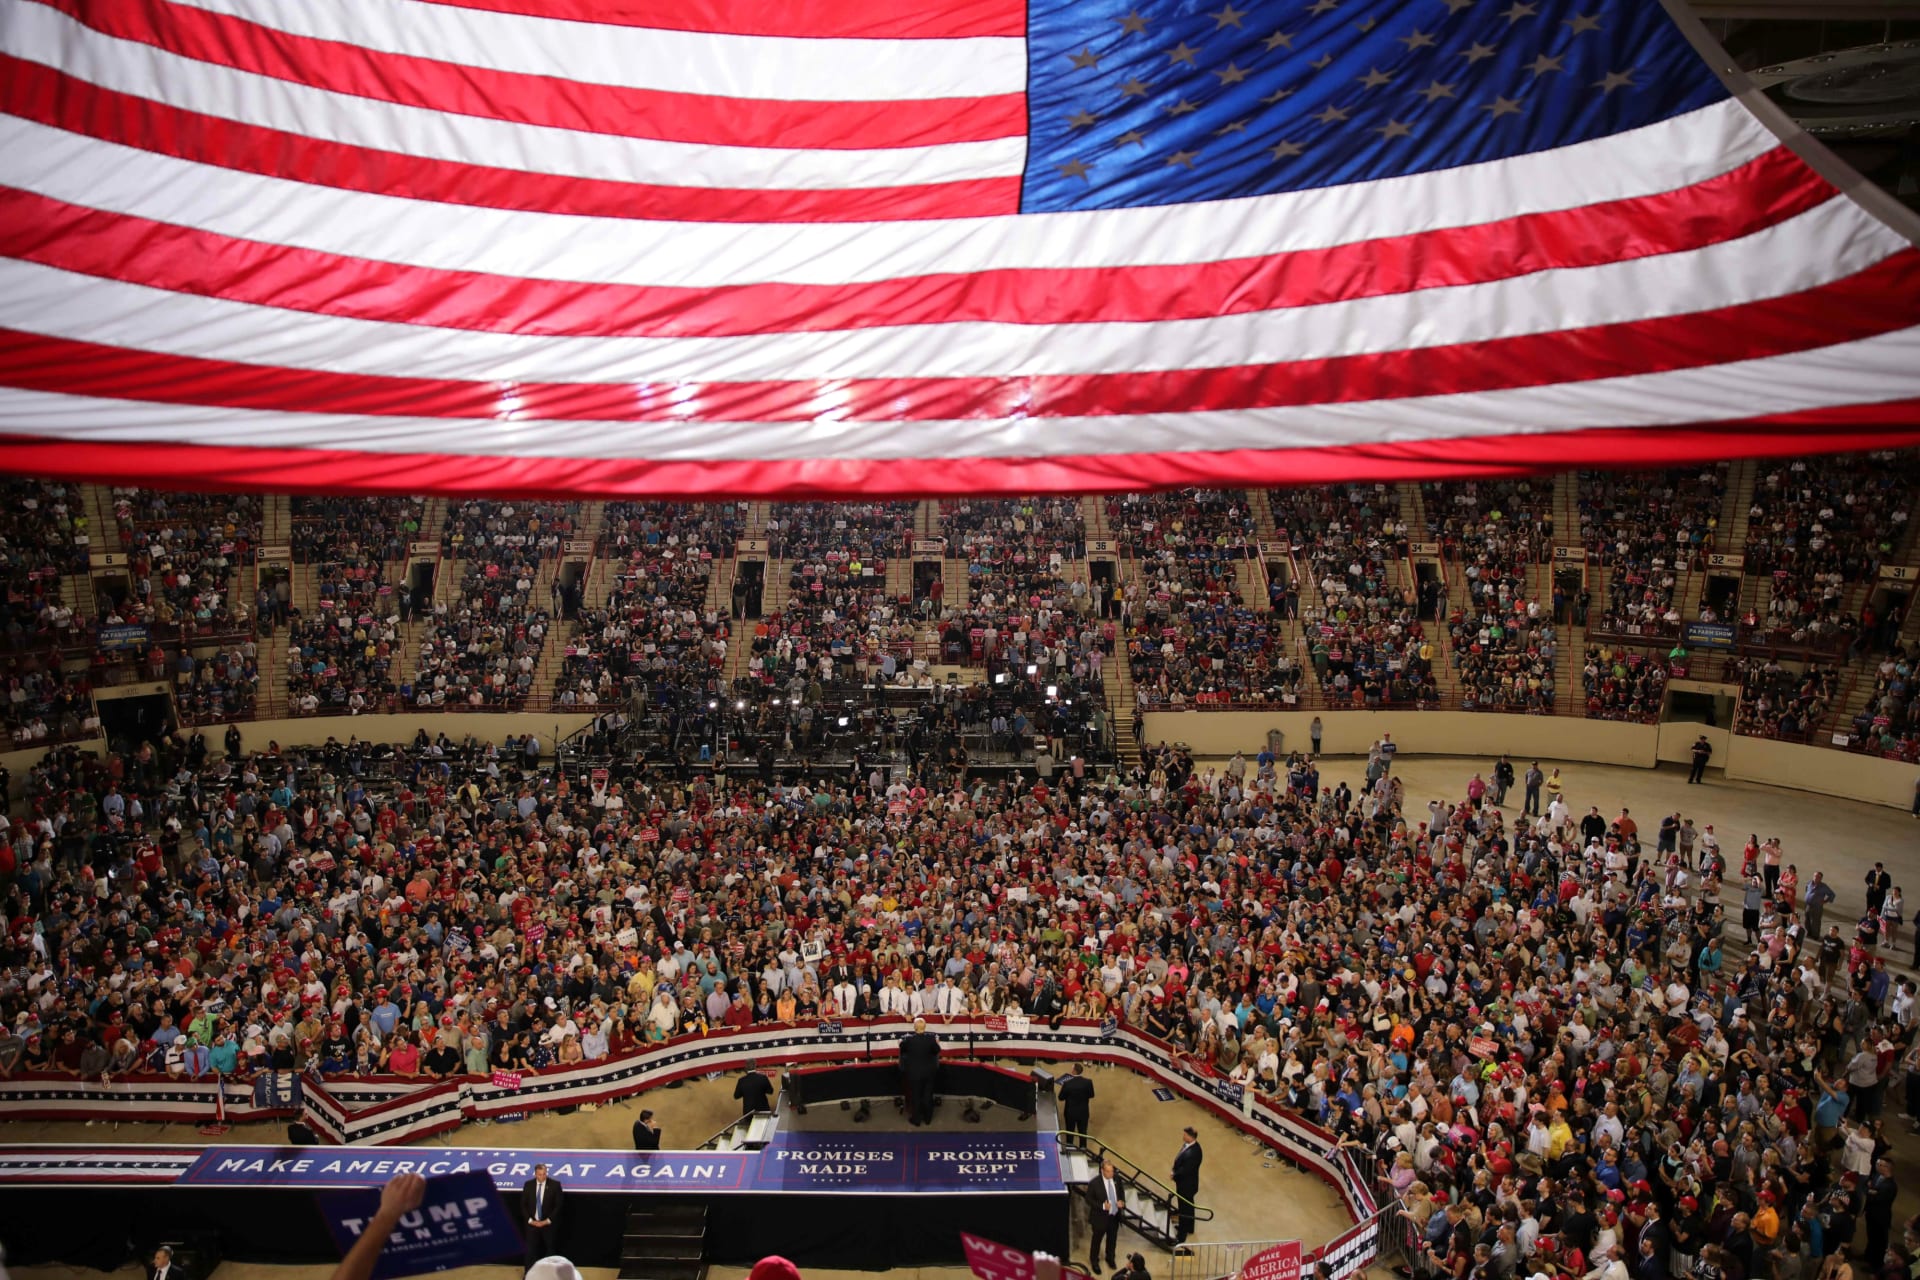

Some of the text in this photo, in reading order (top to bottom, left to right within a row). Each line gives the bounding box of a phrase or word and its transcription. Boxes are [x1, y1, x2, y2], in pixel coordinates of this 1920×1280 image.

[411, 544, 417, 552] 4
[565, 542, 571, 551] 3
[750, 541, 756, 550] 2
[1096, 541, 1106, 550] 36
[1412, 544, 1422, 552] 34
[258, 548, 265, 557] 5
[1556, 548, 1567, 556] 33
[106, 555, 112, 564] 6
[1712, 555, 1724, 564] 32
[1894, 568, 1905, 577] 31
[495, 1070, 522, 1079] WOMEN
[276, 1072, 292, 1102] MP
[494, 1080, 518, 1089] TRUMP
[775, 1150, 894, 1162] PROMISES
[927, 1150, 1046, 1161] PROMISES
[216, 1158, 314, 1173] MAKE
[319, 1159, 472, 1175] AMERICA
[605, 1164, 727, 1179] AGAIN!
[799, 1164, 868, 1175] MADE
[957, 1163, 1019, 1174] KEPT
[342, 1197, 488, 1235] TUMP
[390, 1217, 484, 1243] ENCE
[391, 1241, 429, 1252] AMERICA
[462, 1229, 494, 1240] AGAIN!
[1259, 1251, 1280, 1263] MAKE
[1242, 1256, 1300, 1280] AMERICA
[1271, 1269, 1297, 1280] AGAIN
